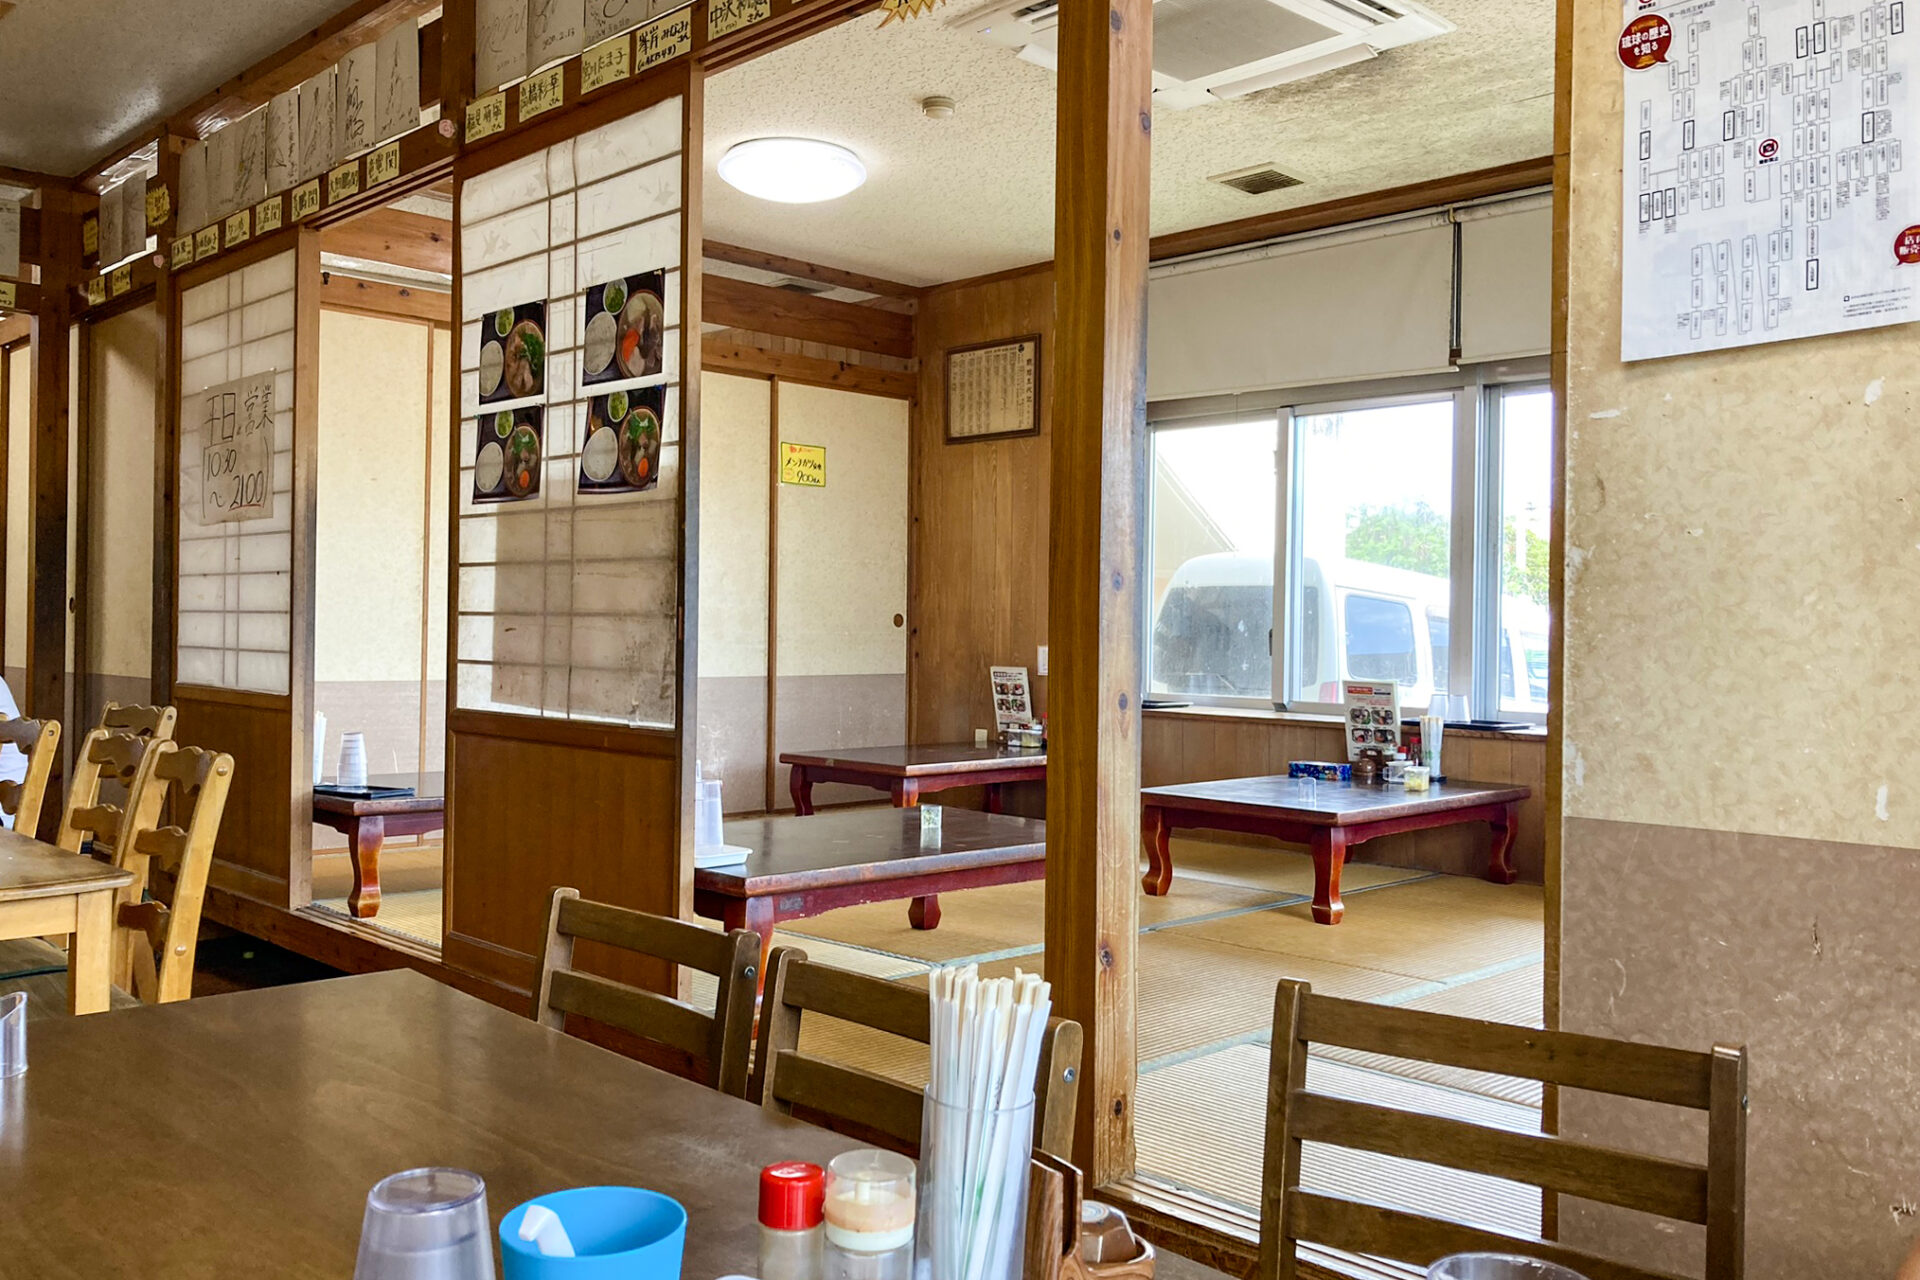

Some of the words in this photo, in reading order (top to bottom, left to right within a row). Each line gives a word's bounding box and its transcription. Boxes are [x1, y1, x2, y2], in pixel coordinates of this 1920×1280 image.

[1621, 25, 1669, 48] 琉球の歴史
[1633, 42, 1659, 55] を知る
